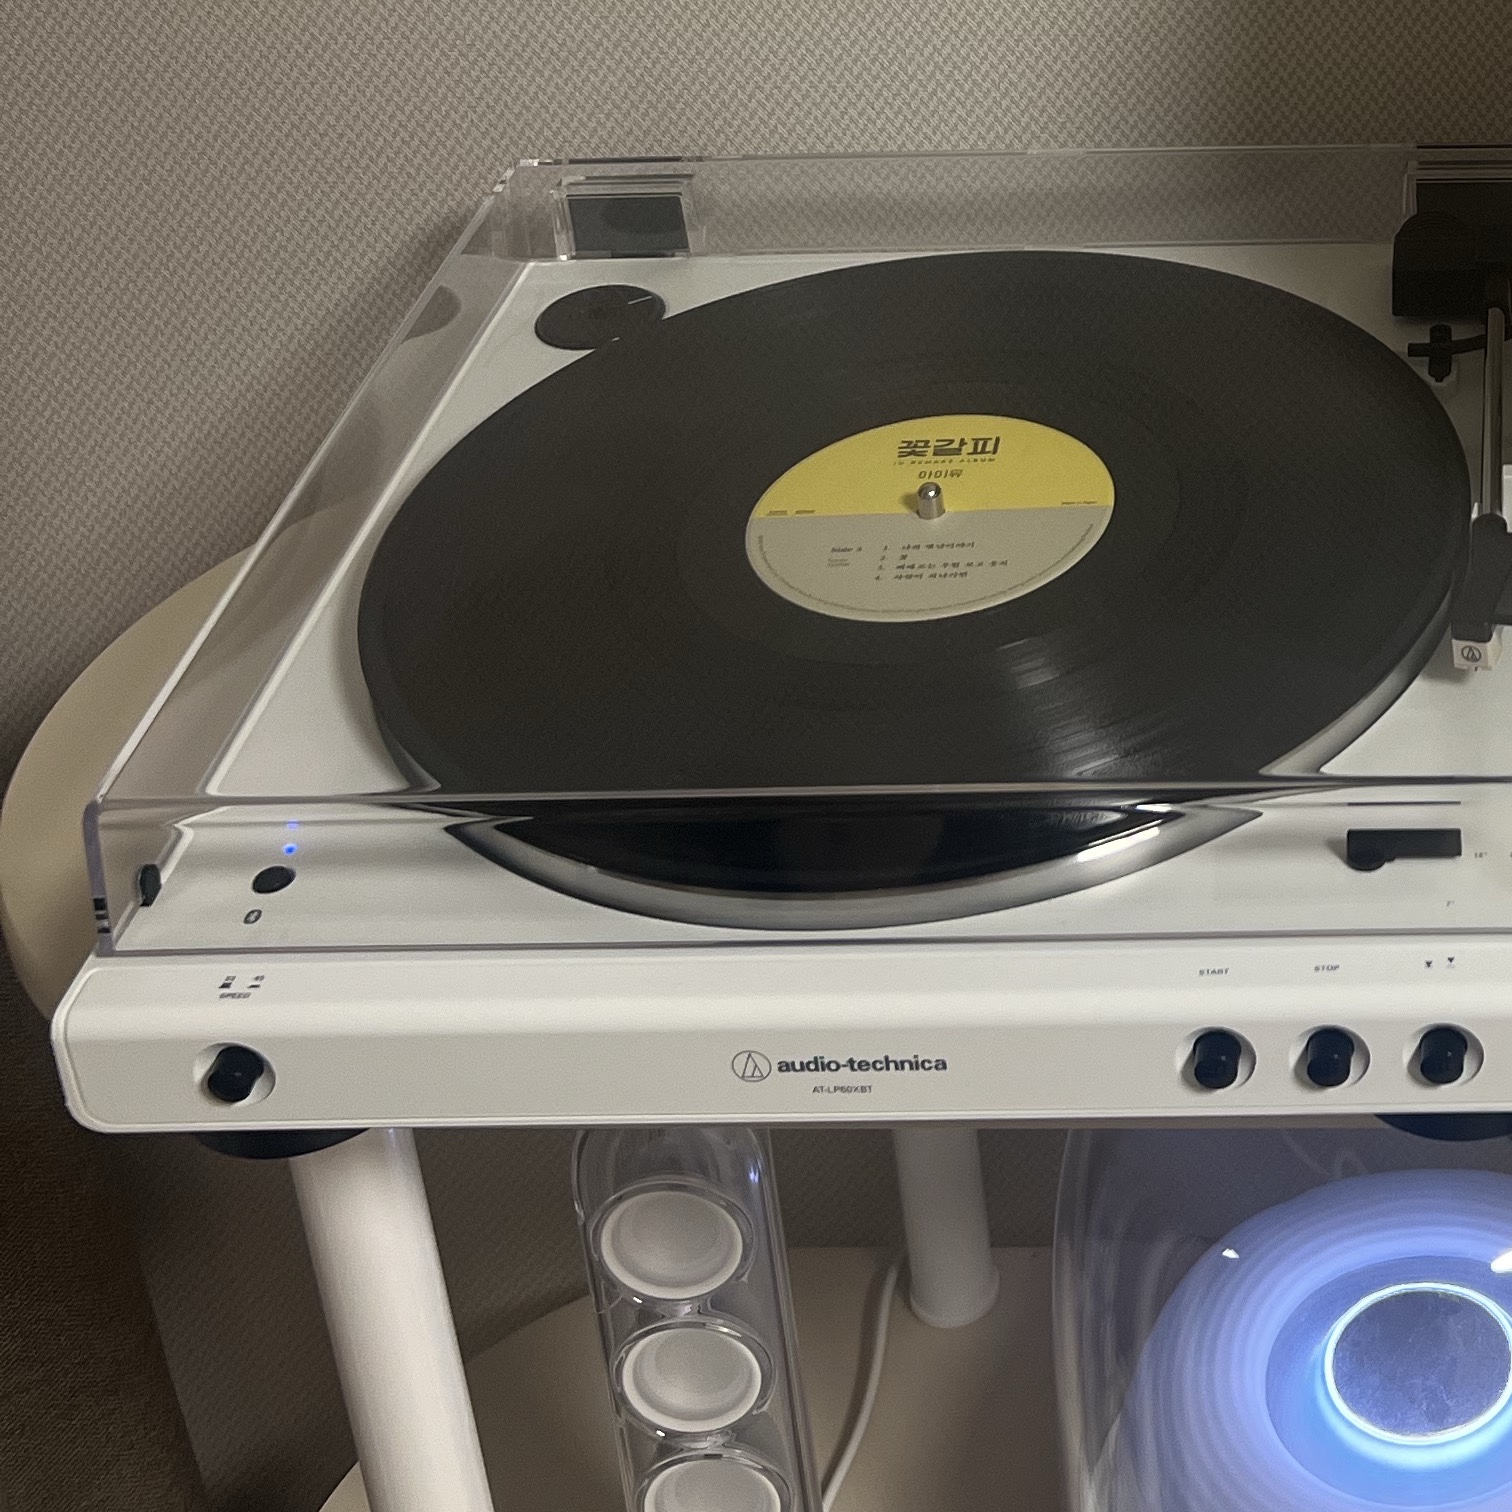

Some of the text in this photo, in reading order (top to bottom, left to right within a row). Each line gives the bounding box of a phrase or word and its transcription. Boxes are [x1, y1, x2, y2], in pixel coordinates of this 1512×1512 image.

[897, 436, 1001, 458] 꽃갈피
[918, 469, 964, 480] 아이유
[1198, 967, 1230, 977] START
[1313, 963, 1340, 973] STOP
[777, 1054, 948, 1073] audio-technica
